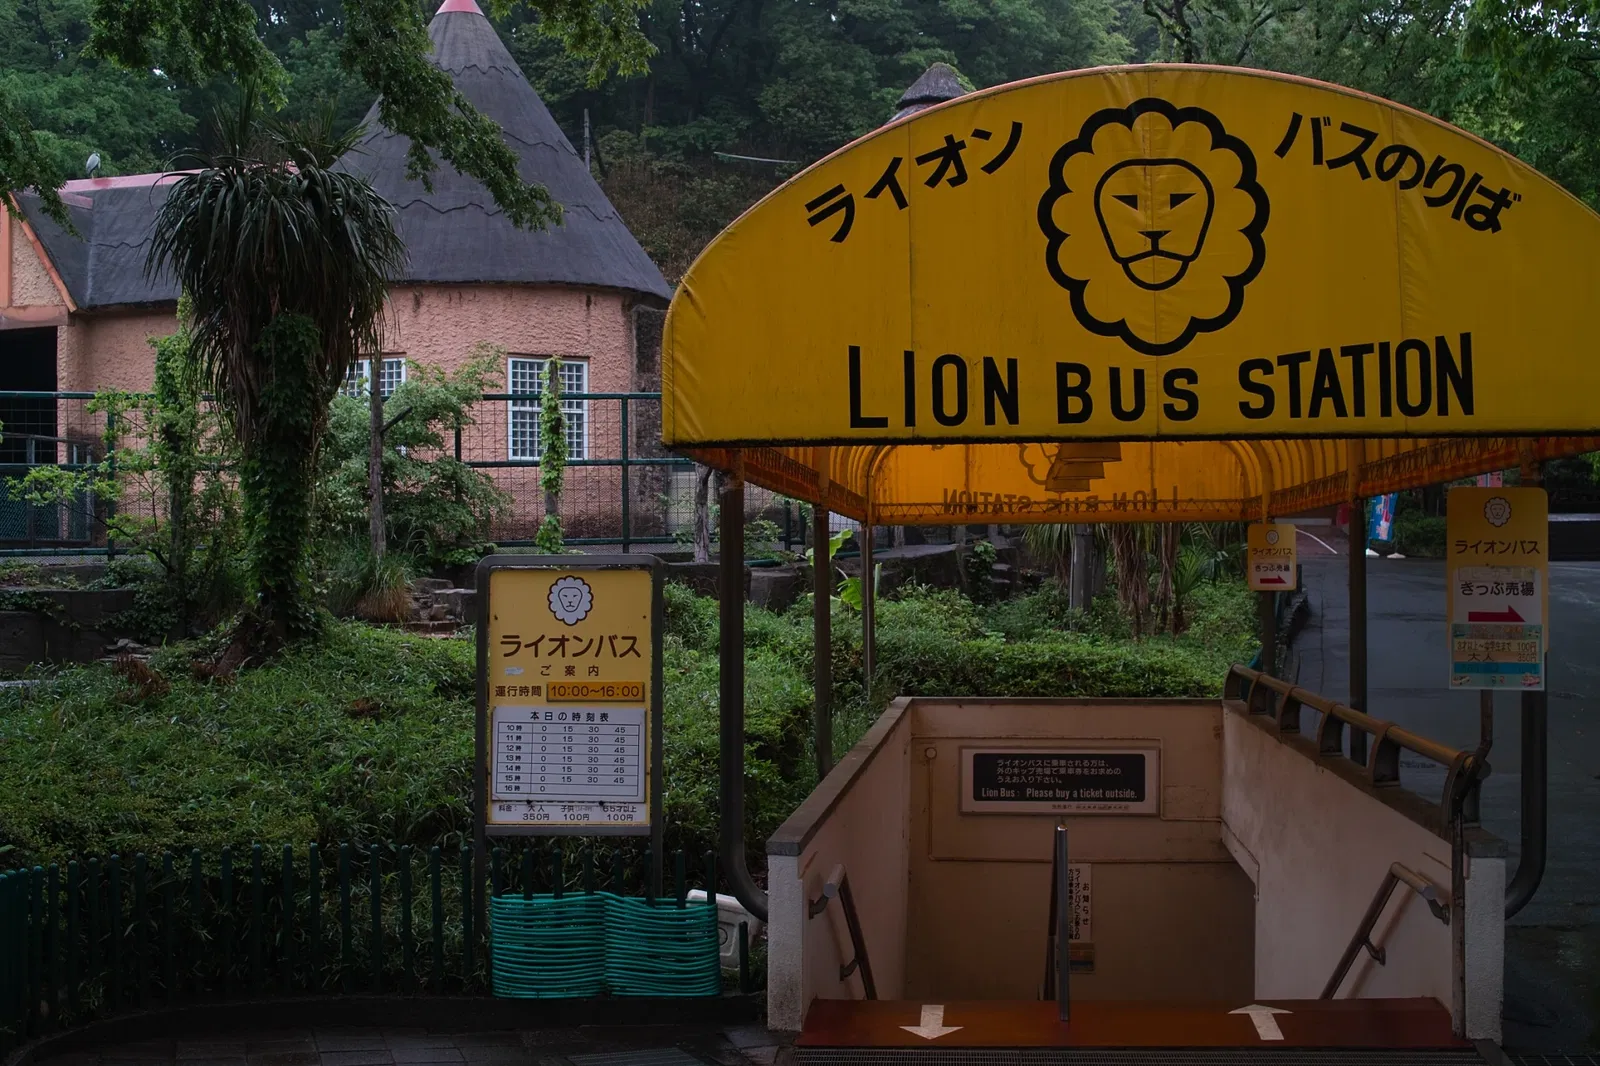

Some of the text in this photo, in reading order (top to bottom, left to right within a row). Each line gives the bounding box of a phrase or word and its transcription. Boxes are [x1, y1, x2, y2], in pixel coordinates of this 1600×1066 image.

[805, 112, 1522, 243] ライオン バスのりば
[849, 332, 1475, 428] LION BUS STATION
[1252, 548, 1293, 556] ライオンバス
[1455, 540, 1540, 555] ライオンバス
[500, 634, 641, 658] ライオンバス
[541, 664, 599, 676] ご案内
[495, 686, 542, 697] 運行時間
[530, 711, 609, 722] 本日の時刻表
[996, 776, 1063, 784] うえお入り下さい。
[982, 788, 998, 797] Lion
[1026, 787, 1053, 798] Please
[1056, 788, 1069, 800] buy
[1072, 790, 1078, 798] a
[1080, 788, 1103, 798] ticket
[1105, 788, 1138, 799] outside.
[528, 804, 545, 812] 大人
[560, 804, 574, 812] 子供
[522, 813, 634, 821] 350円 100円 100円
[1082, 883, 1090, 926] お知らせ
